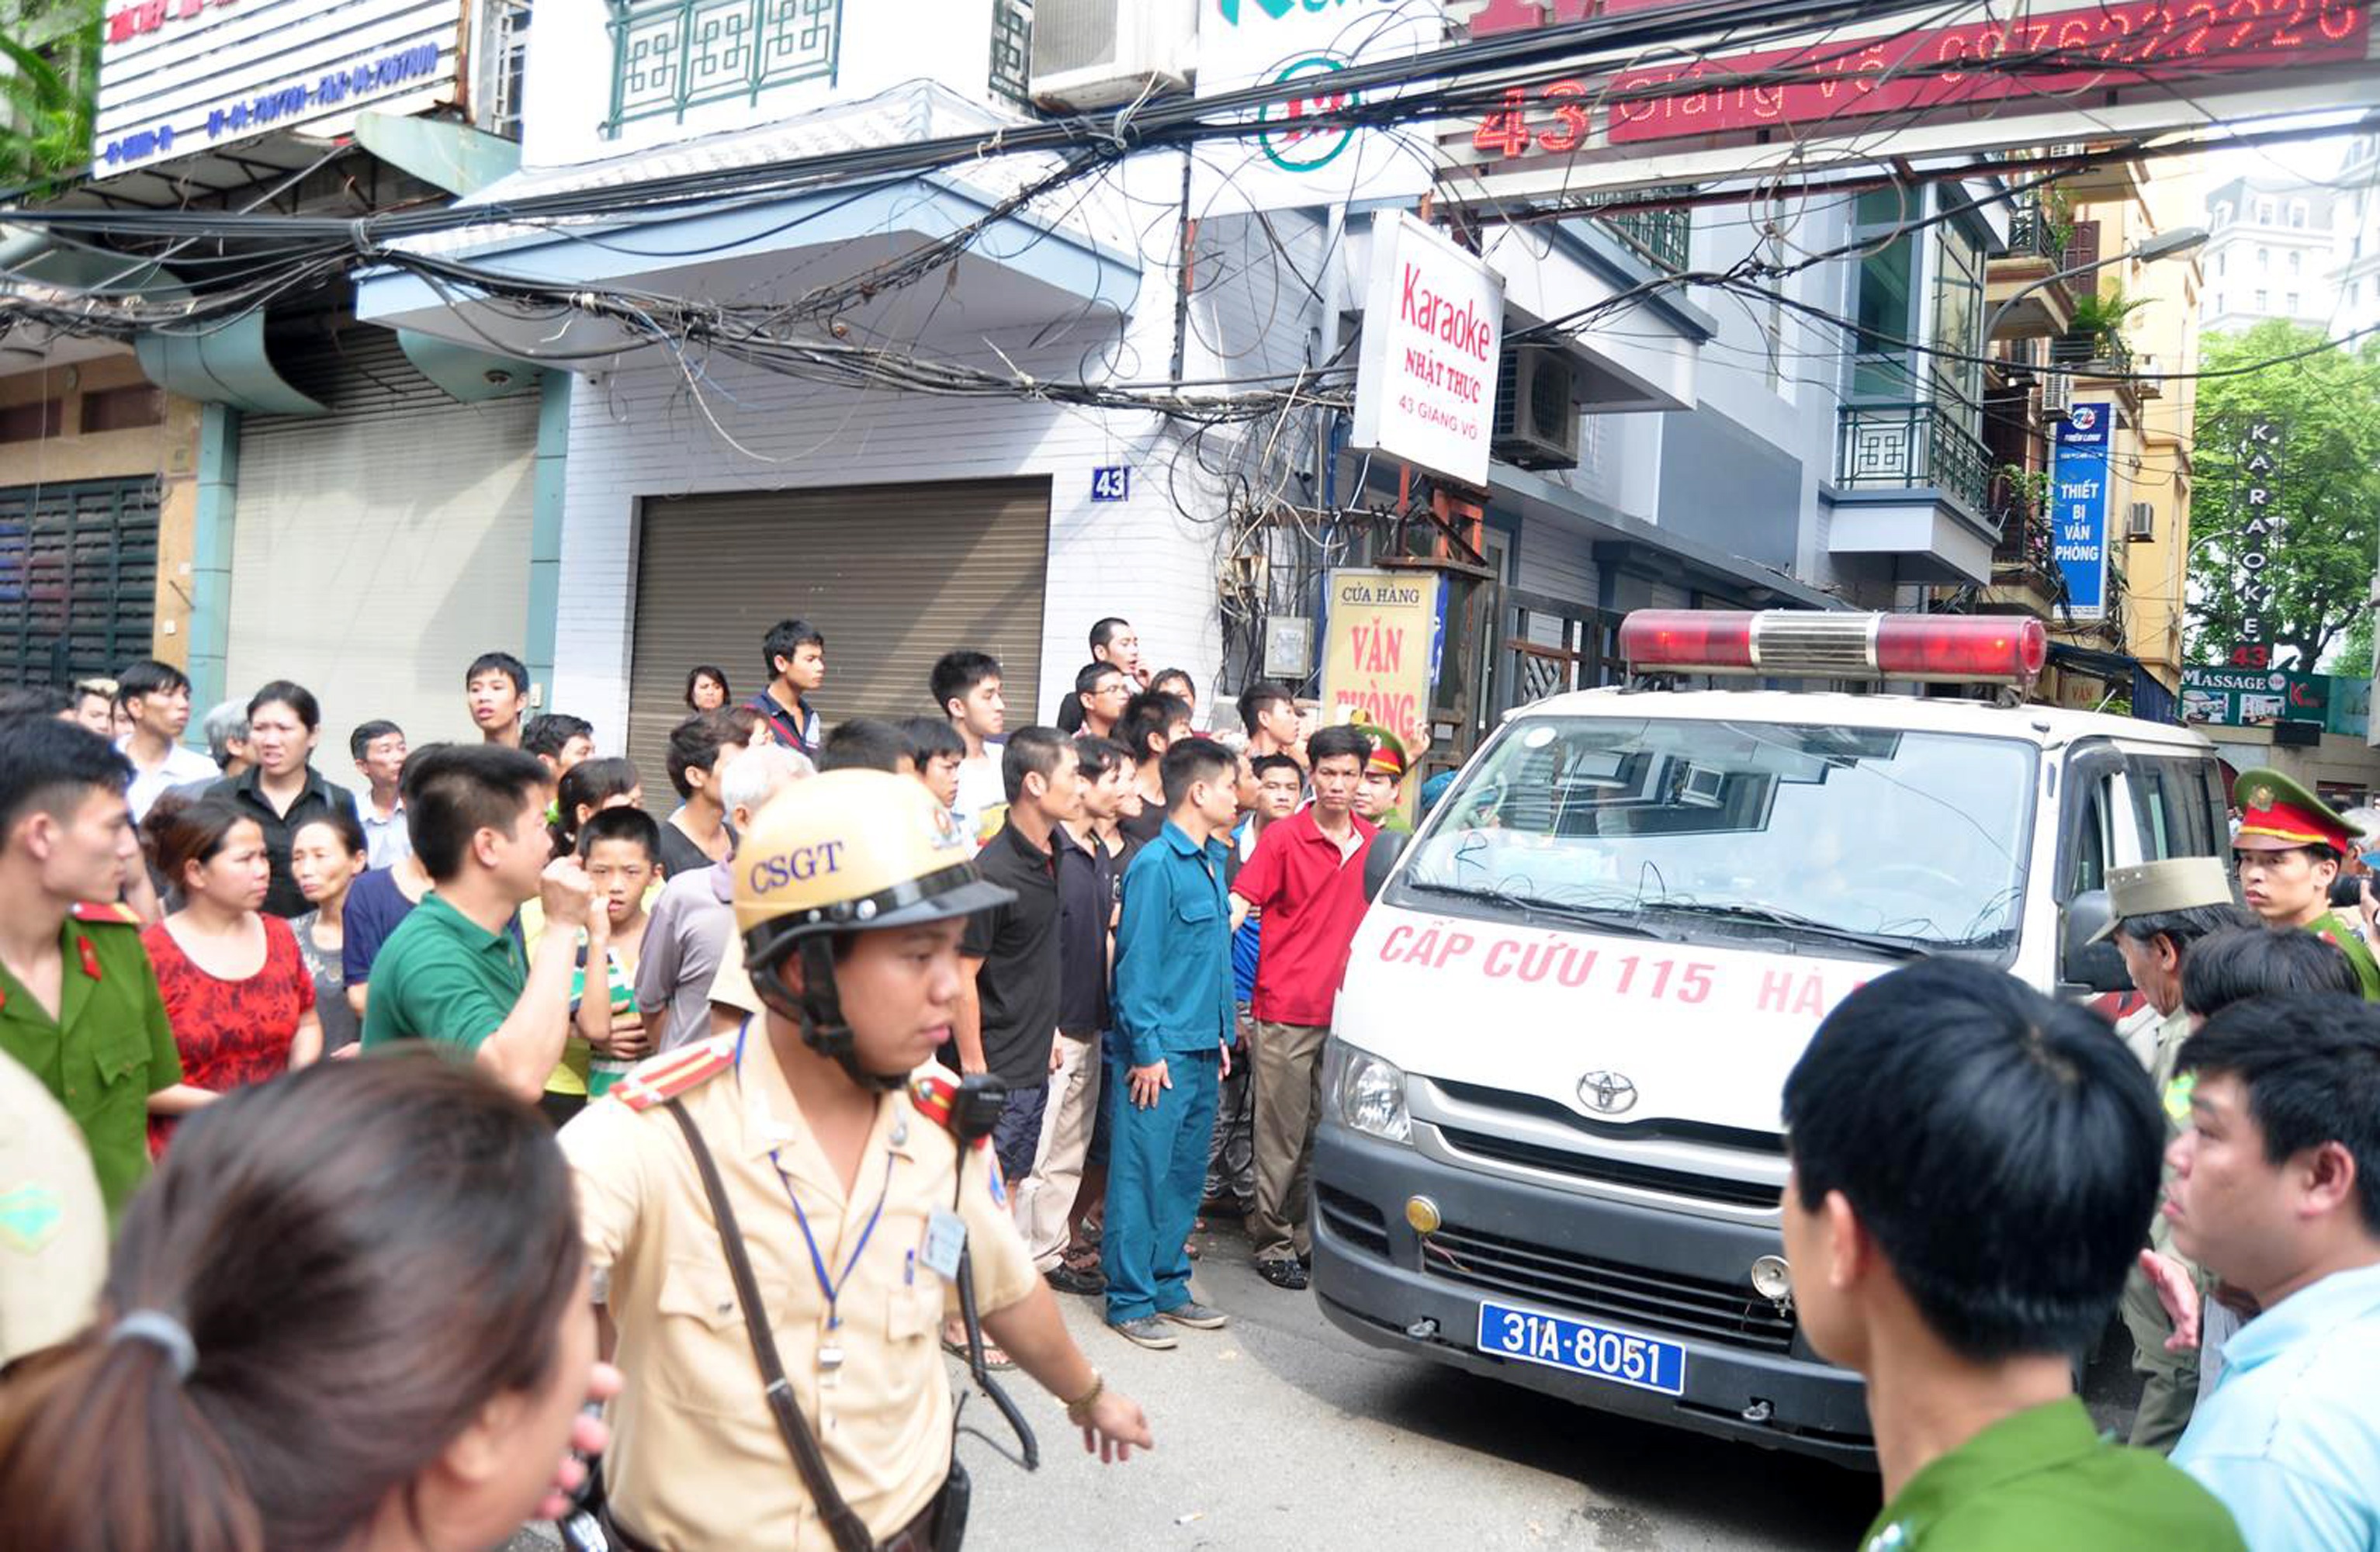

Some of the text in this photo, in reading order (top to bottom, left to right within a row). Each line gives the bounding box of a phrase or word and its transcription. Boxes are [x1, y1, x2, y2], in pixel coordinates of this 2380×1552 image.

[1473, 78, 1588, 158] 43
[1401, 262, 1491, 362] Karaoke
[1398, 394, 1415, 414] 43
[1096, 470, 1124, 497] 43
[2060, 479, 2100, 499] THIẾT
[2072, 504, 2086, 522] BỊ
[2064, 521, 2091, 541] VĂN
[2242, 424, 2271, 634] KARAOKE
[2055, 542, 2100, 561] PHÒNG
[1342, 582, 1419, 604] CỬA HÀNG
[1352, 616, 1404, 673] VĂN
[2232, 646, 2267, 669] 43
[2181, 669, 2266, 690] MASSAGE
[1336, 680, 1415, 738] ÒNG
[750, 840, 843, 894] CSGT
[1380, 920, 1824, 1018] CẤP CỨU 115 HÀ
[1502, 1313, 1659, 1384] 31A-8051
